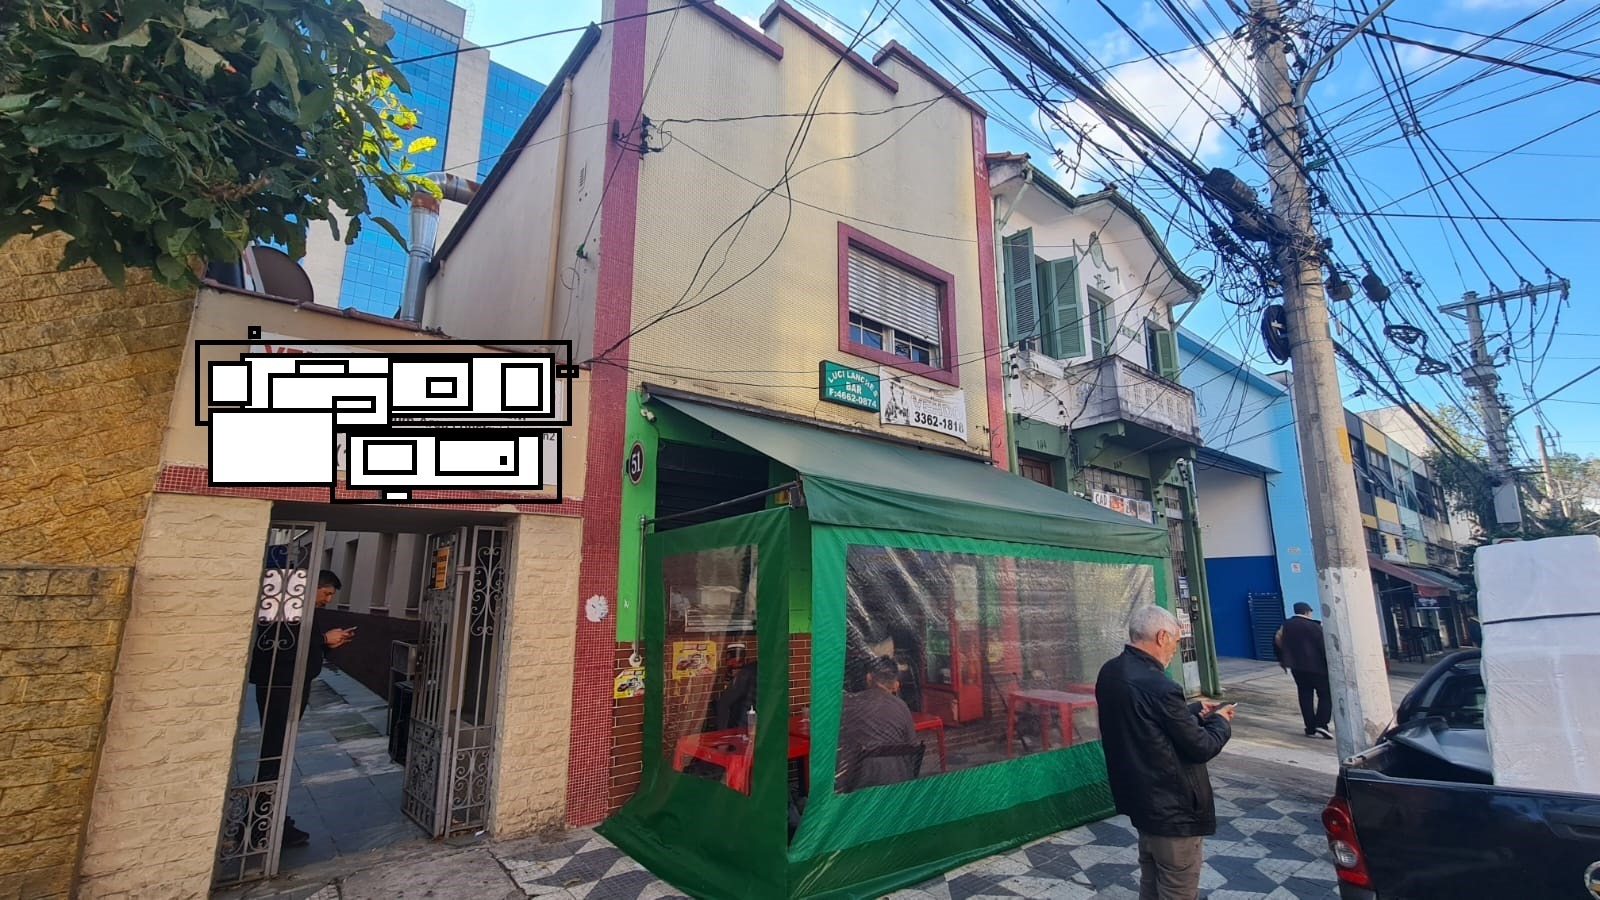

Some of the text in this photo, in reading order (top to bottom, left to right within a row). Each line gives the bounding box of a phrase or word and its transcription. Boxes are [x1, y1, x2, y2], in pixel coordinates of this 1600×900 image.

[828, 370, 845, 383] LUCI
[846, 381, 862, 395] BAR
[631, 451, 641, 474] 51
